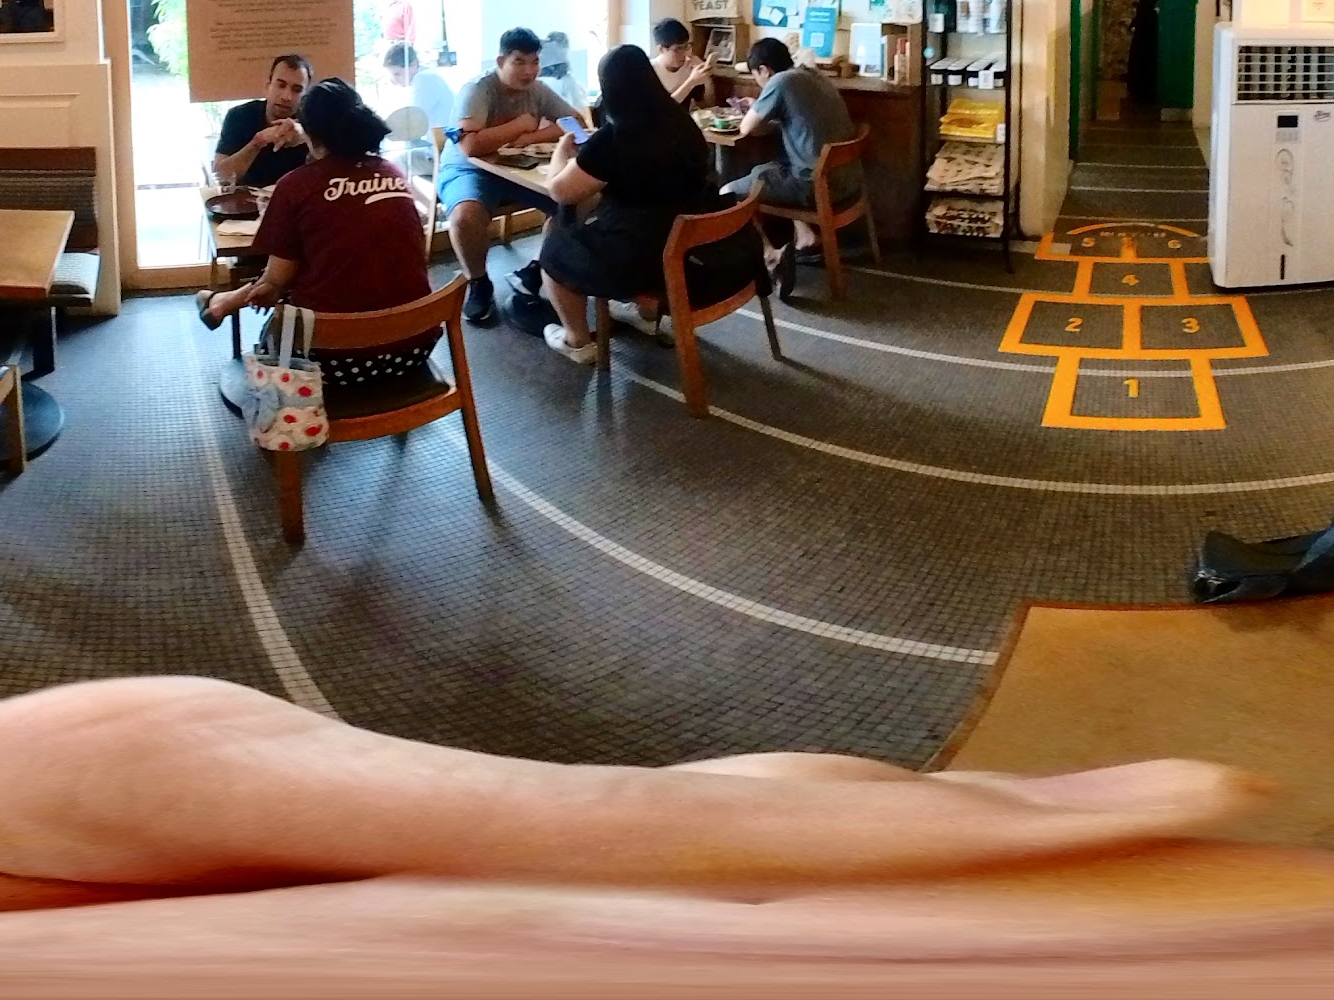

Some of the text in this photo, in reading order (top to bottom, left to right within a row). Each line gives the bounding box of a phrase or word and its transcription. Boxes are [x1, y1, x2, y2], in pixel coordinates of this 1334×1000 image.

[692, 0, 728, 11] YEAST
[323, 172, 411, 202] Traine
[1122, 274, 1140, 286] 4
[1065, 318, 1200, 333] 2 3
[1124, 378, 1140, 398] 1
